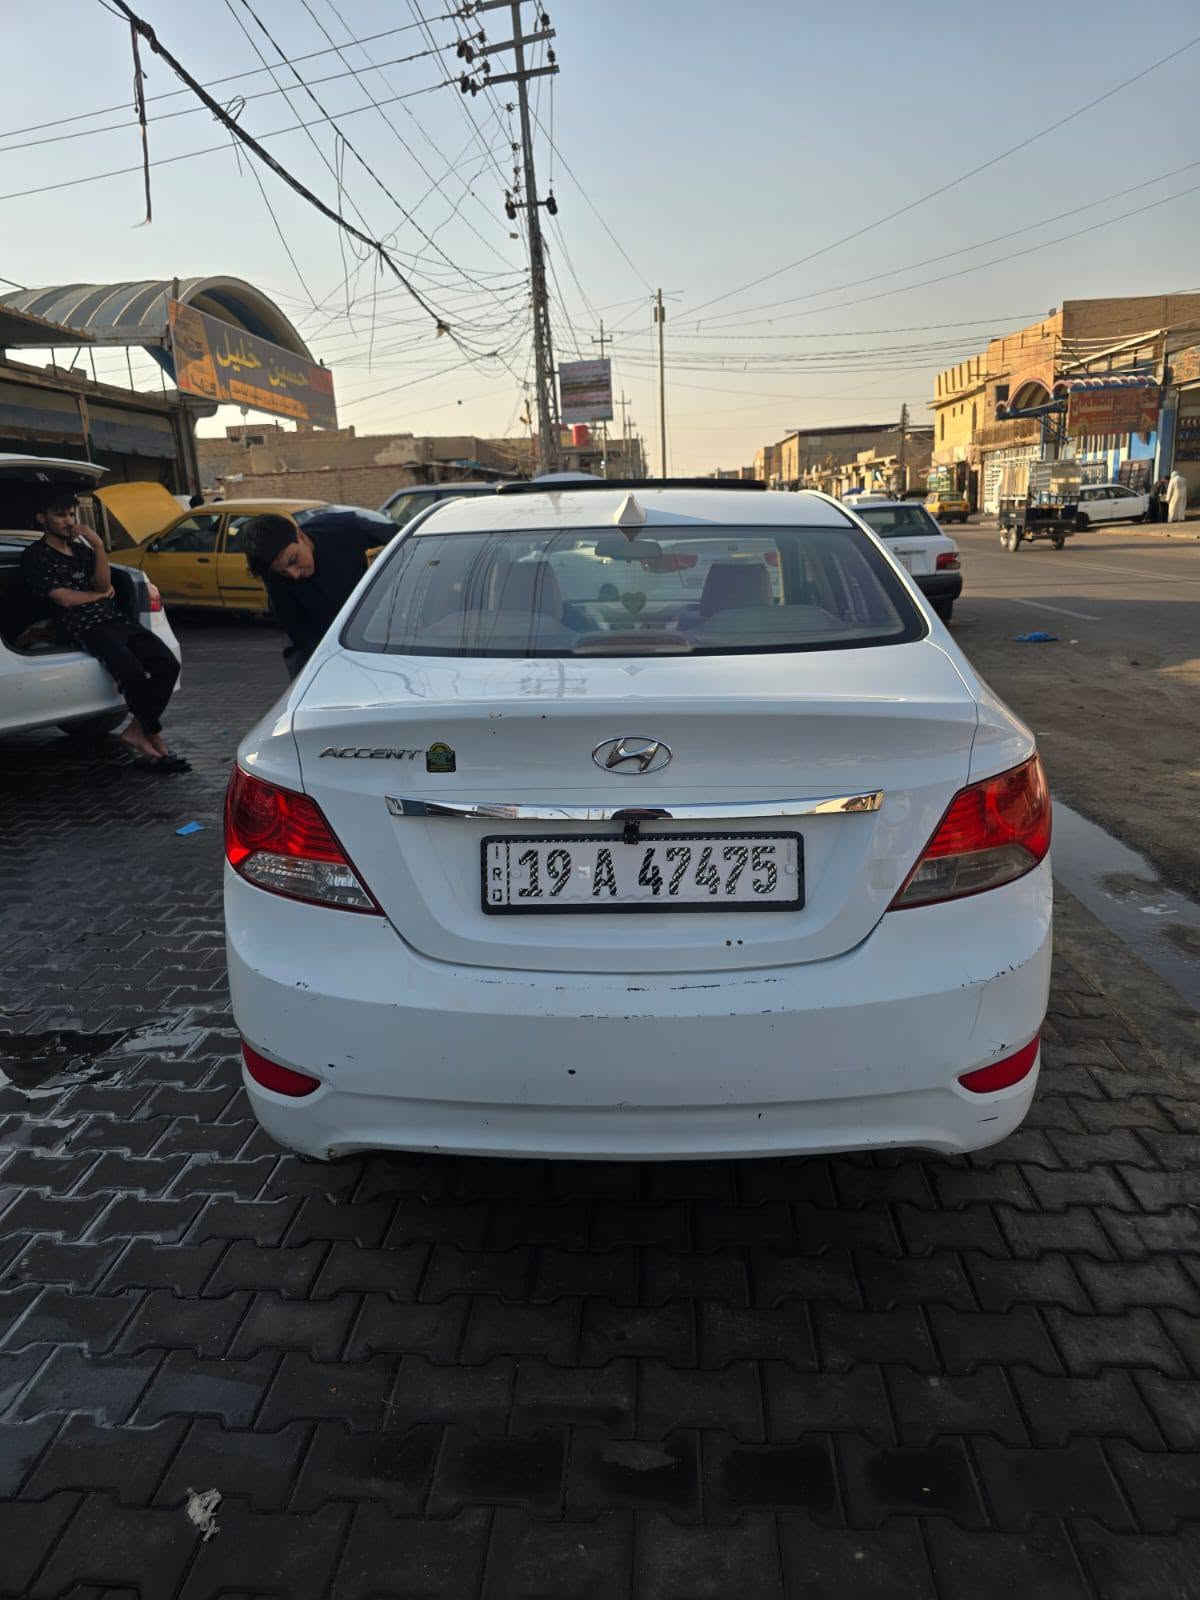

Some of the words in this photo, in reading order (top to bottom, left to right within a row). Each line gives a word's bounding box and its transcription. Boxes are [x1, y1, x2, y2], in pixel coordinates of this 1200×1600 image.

[319, 745, 422, 761] ACCENT
[518, 848, 572, 897] 19
[592, 848, 619, 896] A
[638, 846, 777, 895] 47475
